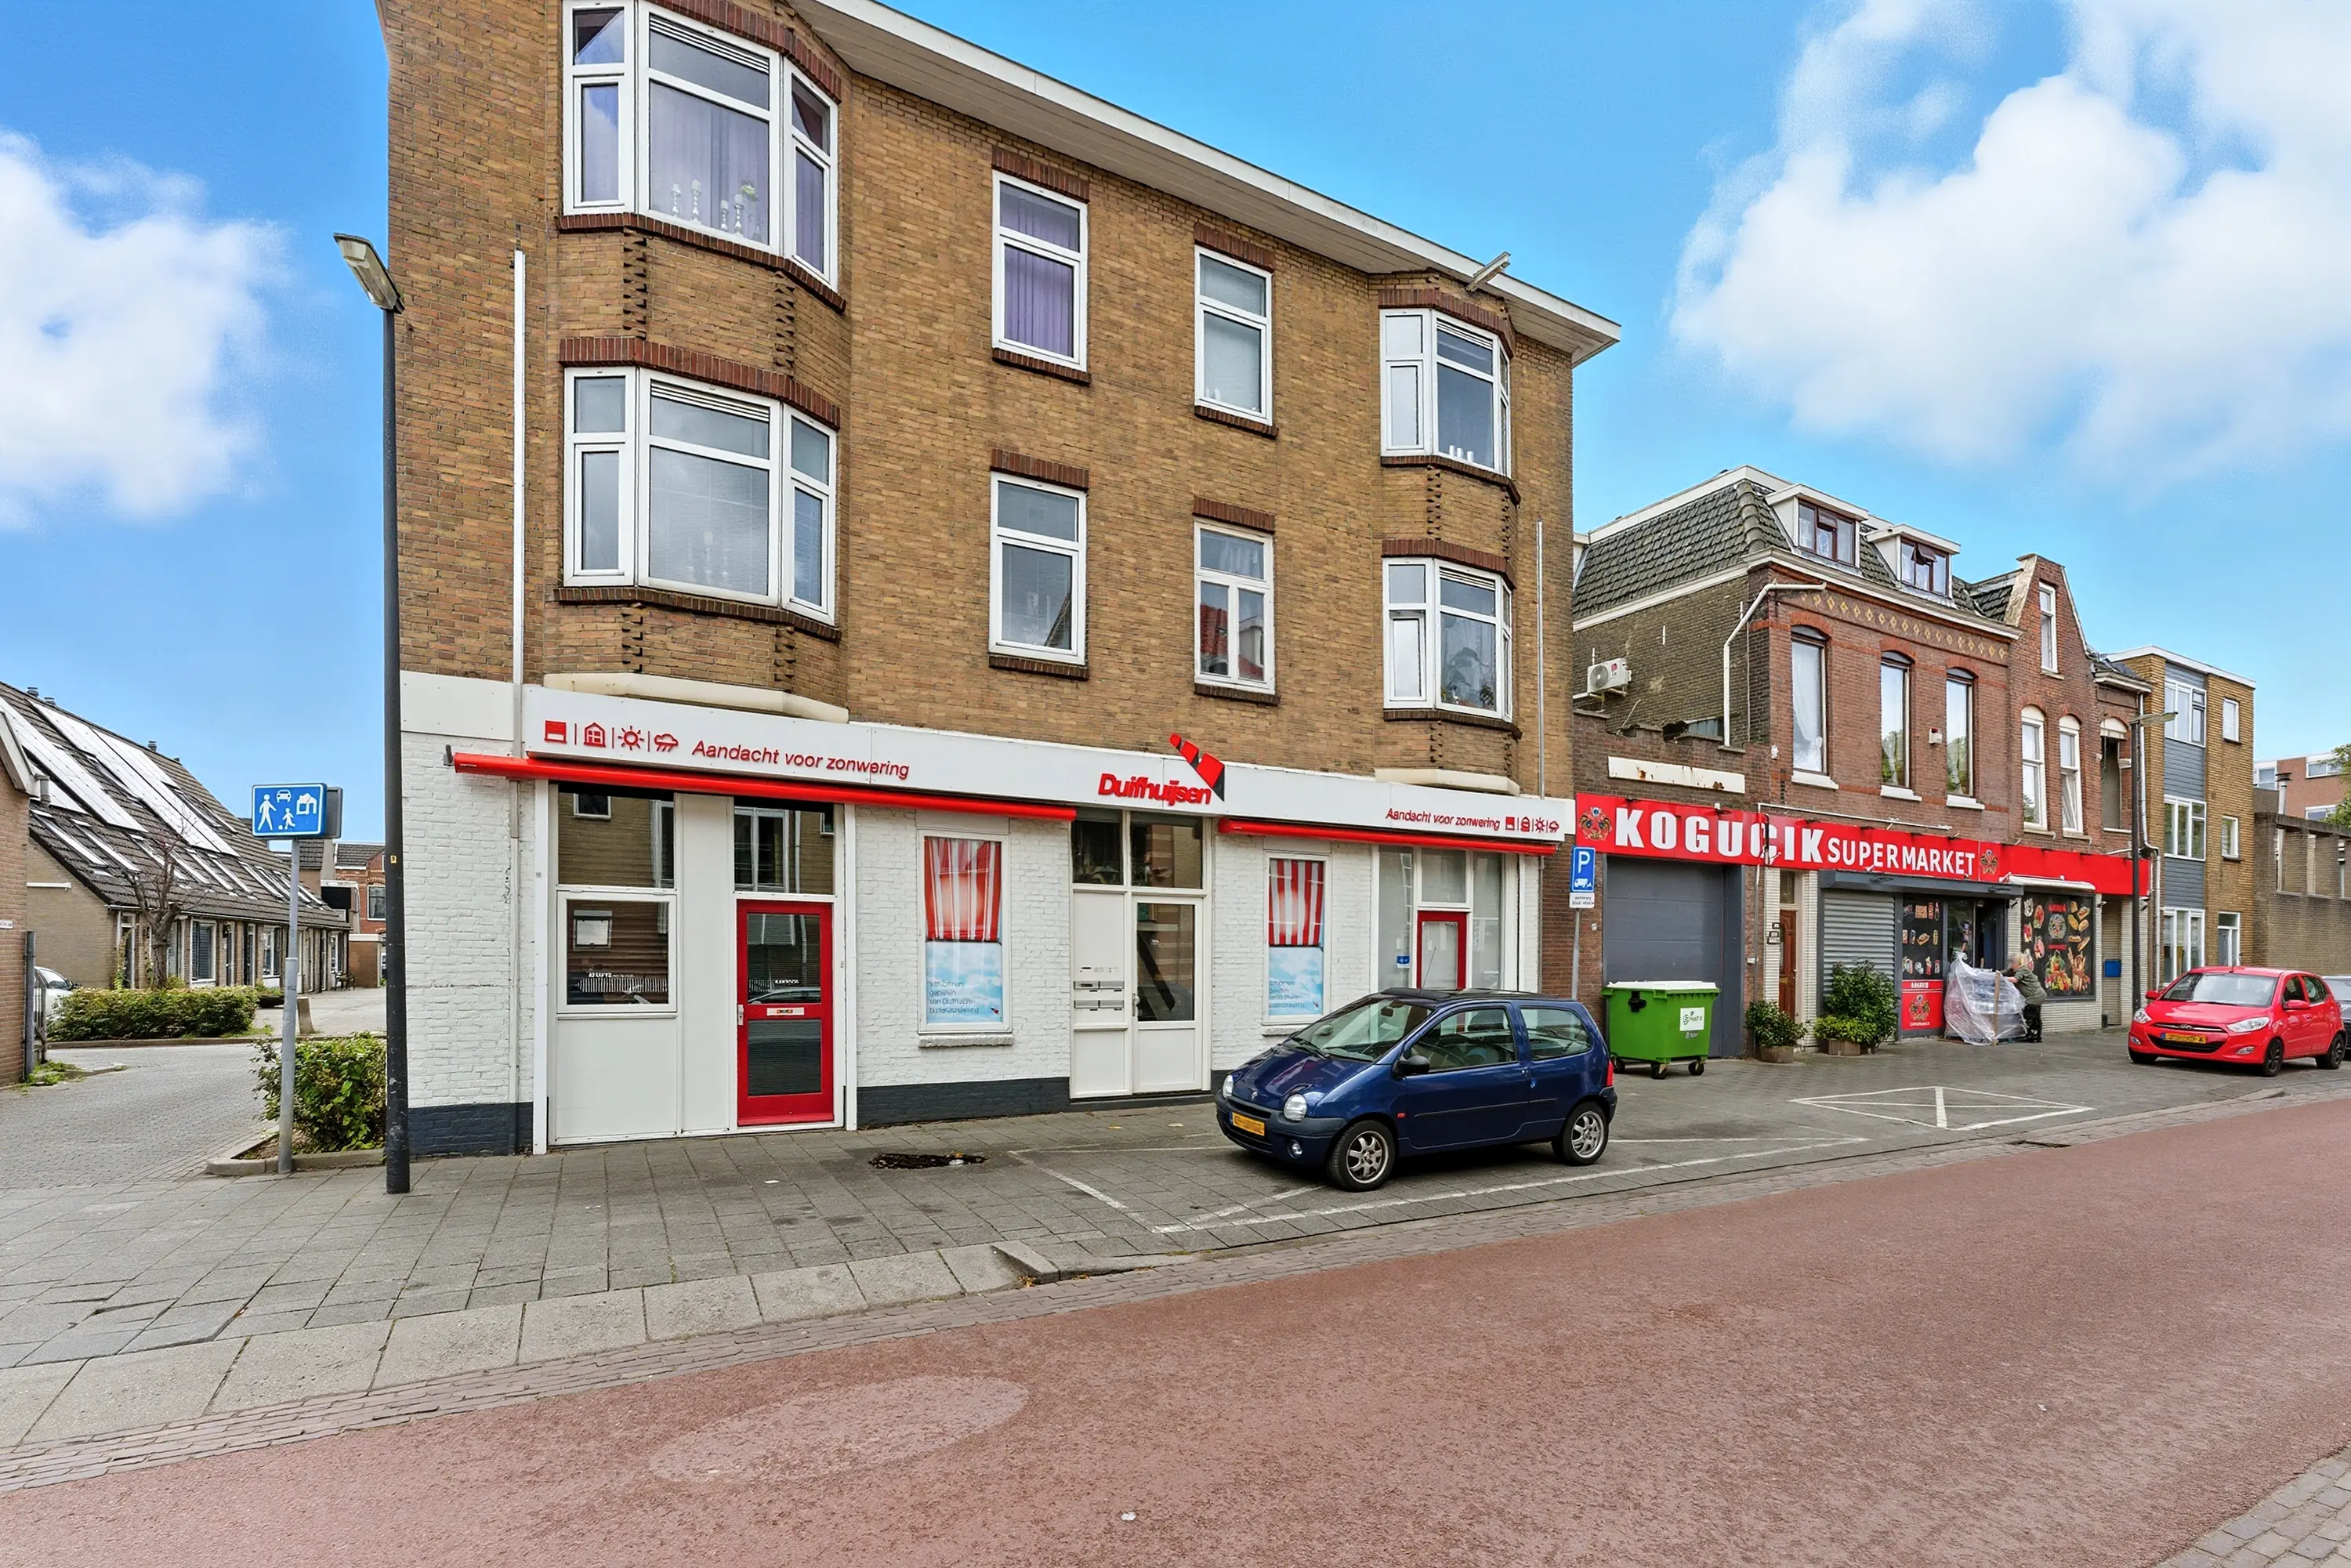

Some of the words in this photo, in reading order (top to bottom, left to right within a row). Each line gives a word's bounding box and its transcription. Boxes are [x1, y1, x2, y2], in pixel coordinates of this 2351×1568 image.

[691, 740, 780, 764] Aandacht
[784, 753, 824, 768] voor
[826, 757, 910, 780] zonwering
[1098, 773, 1212, 806] Duifhuijsen
[1386, 808, 1431, 823] Aandacht
[1433, 814, 1454, 824] voor
[1455, 817, 1501, 831] zonwering
[1615, 807, 1824, 864] KOGUCIK
[1827, 837, 1976, 876] SUPERMARKET
[1578, 850, 1591, 874] P
